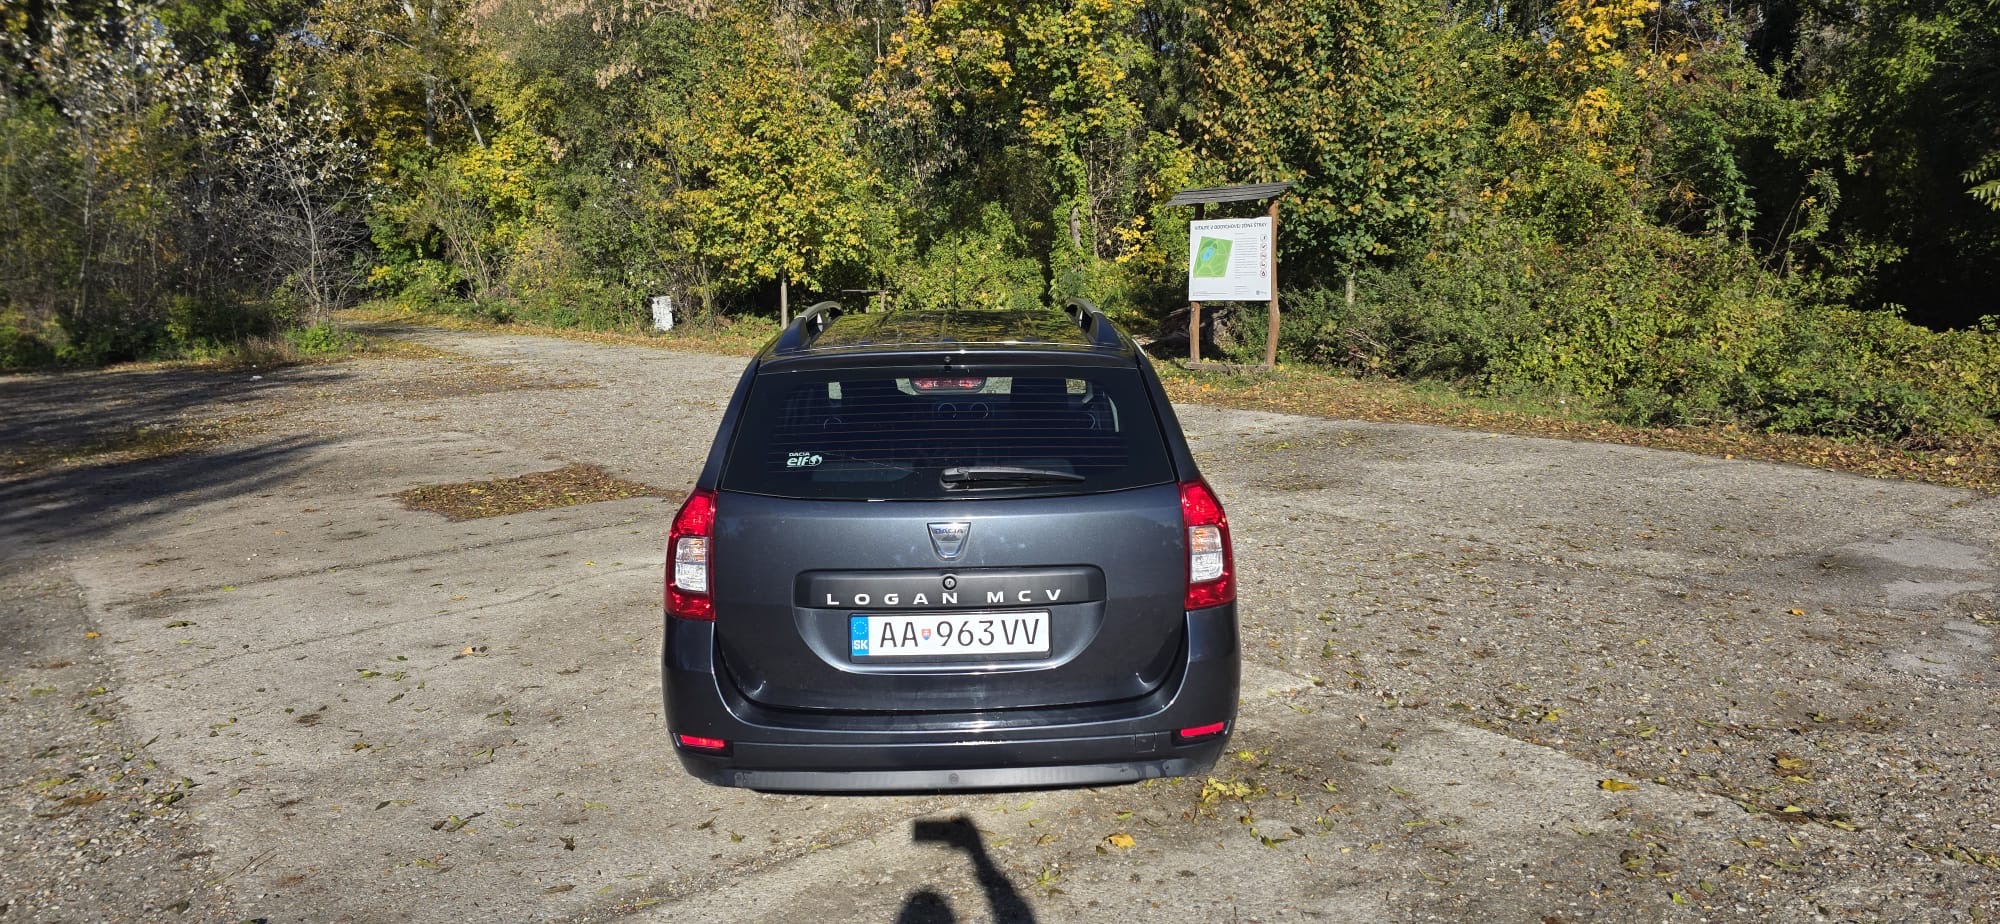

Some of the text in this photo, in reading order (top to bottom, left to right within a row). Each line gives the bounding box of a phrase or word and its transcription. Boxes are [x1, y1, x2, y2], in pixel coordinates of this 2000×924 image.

[787, 457, 810, 466] elf
[827, 589, 1061, 605] LOGAN MCV
[880, 618, 1040, 648] AA 963VV
[853, 640, 868, 650] SK
